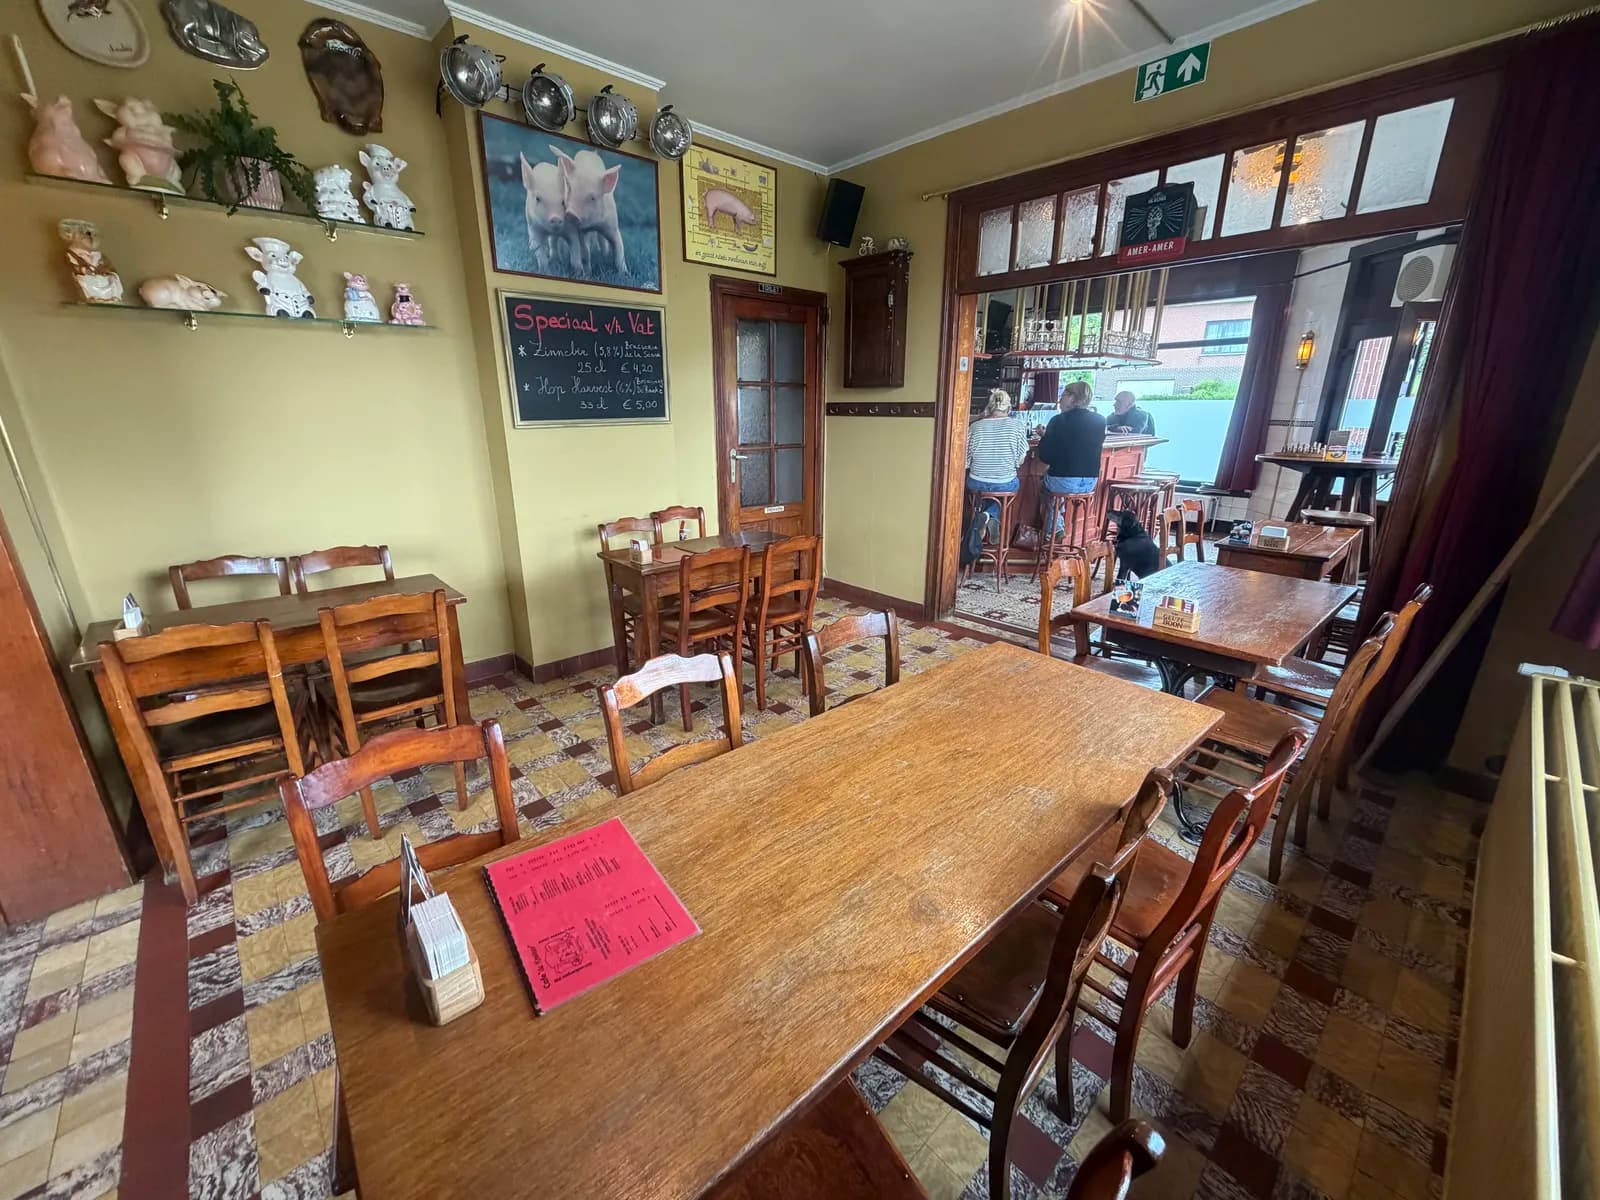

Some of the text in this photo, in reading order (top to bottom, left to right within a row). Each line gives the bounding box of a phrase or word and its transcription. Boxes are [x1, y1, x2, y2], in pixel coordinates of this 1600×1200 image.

[1127, 241, 1174, 257] AMER-AMER
[514, 304, 655, 343] Speciaal v/h Vat
[577, 361, 592, 373] 25
[621, 362, 631, 374] €
[633, 362, 654, 375] 4,20
[536, 376, 567, 401] Hop
[571, 375, 614, 394] Harvest
[580, 401, 594, 409] 33
[623, 398, 632, 410] €
[635, 400, 658, 411] 5,00
